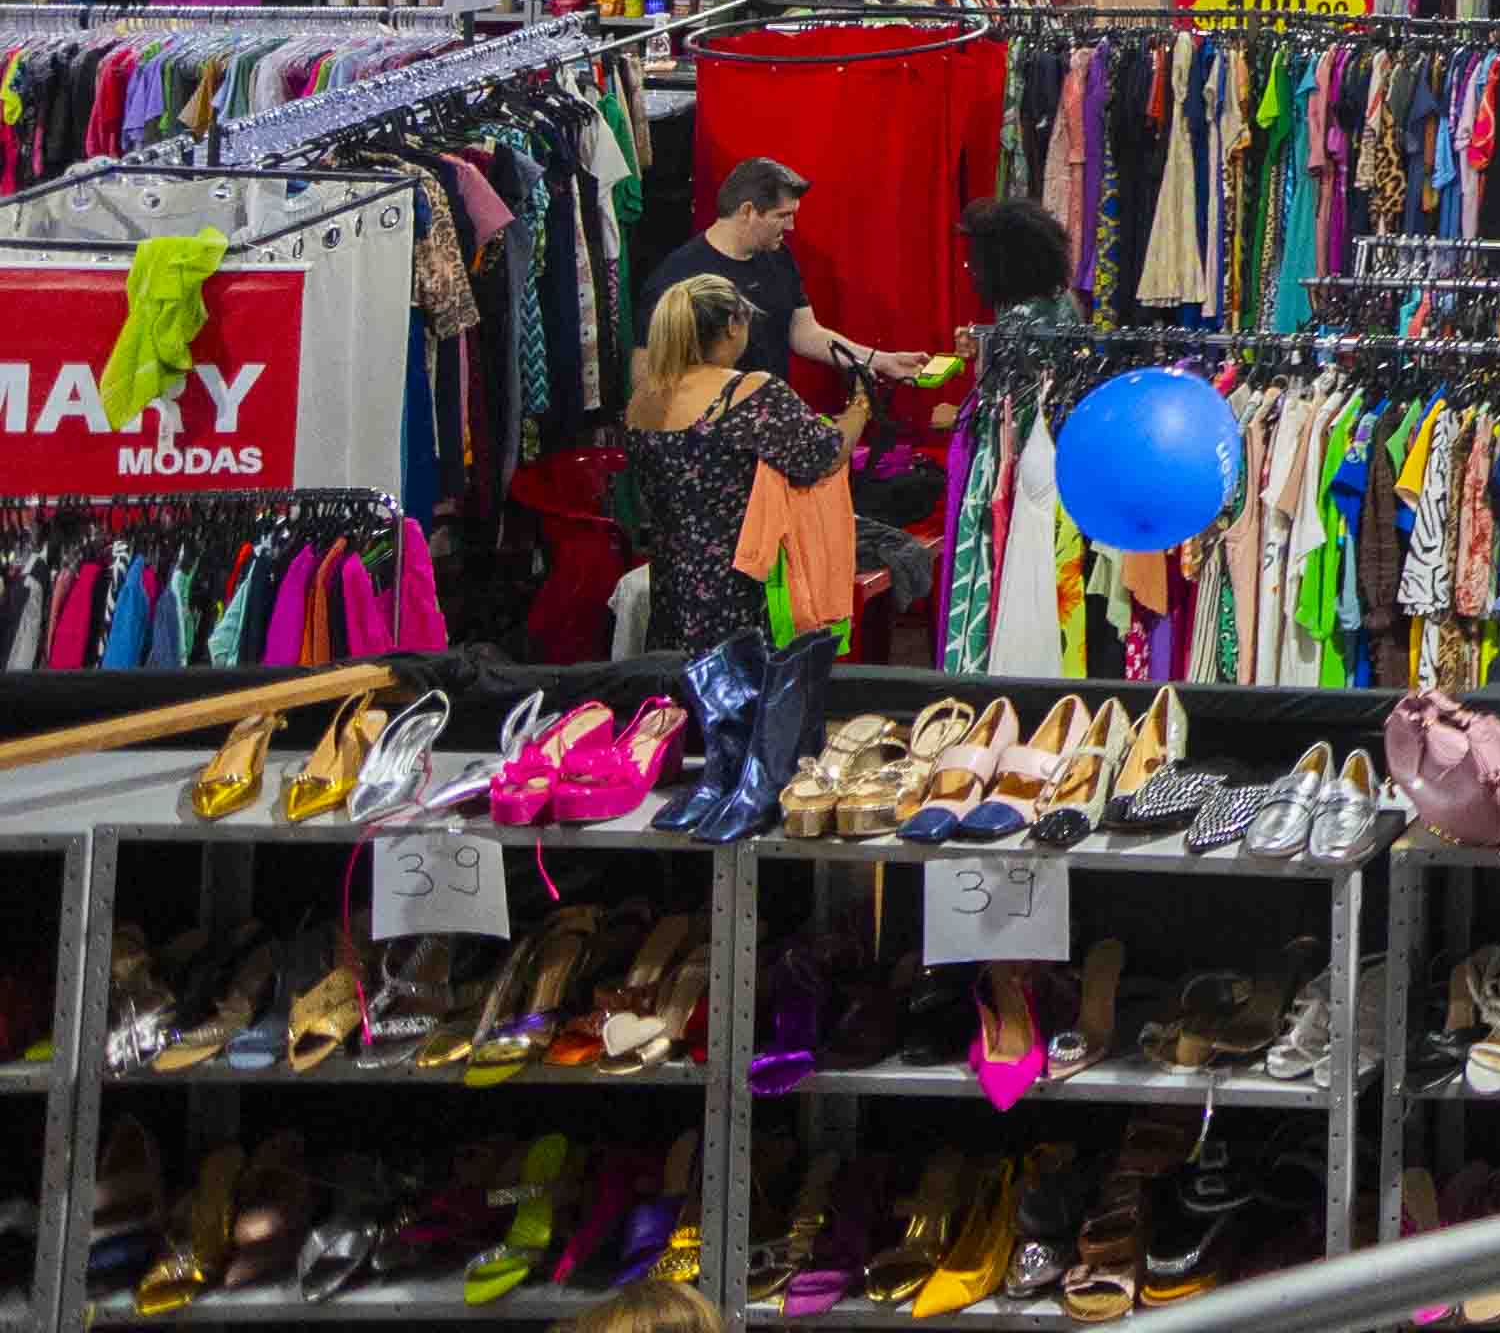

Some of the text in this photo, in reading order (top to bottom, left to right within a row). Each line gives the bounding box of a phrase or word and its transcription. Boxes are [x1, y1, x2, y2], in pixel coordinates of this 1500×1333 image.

[117, 445, 264, 476] MODAS
[390, 844, 481, 897] 39
[951, 867, 1036, 919] 39
